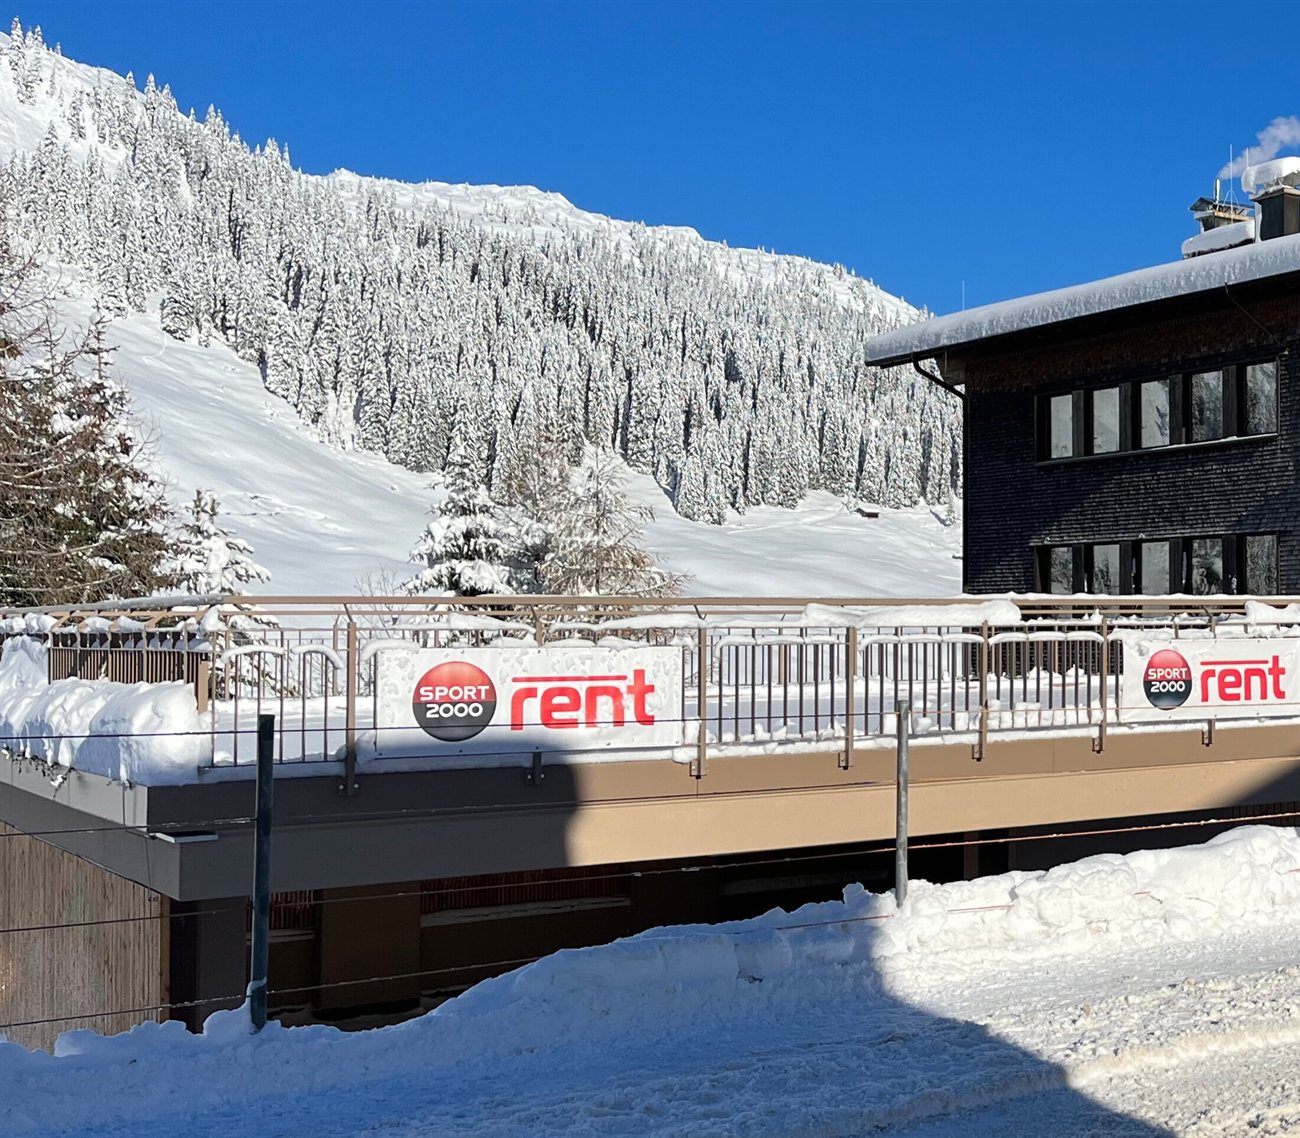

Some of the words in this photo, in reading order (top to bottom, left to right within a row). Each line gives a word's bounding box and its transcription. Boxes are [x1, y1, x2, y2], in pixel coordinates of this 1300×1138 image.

[1148, 667, 1188, 680] SPORT
[1200, 655, 1286, 702] rent
[419, 685, 490, 701] SPORT
[1150, 681, 1186, 693] 2000
[510, 669, 655, 731] rent
[426, 702, 484, 718] 2000
